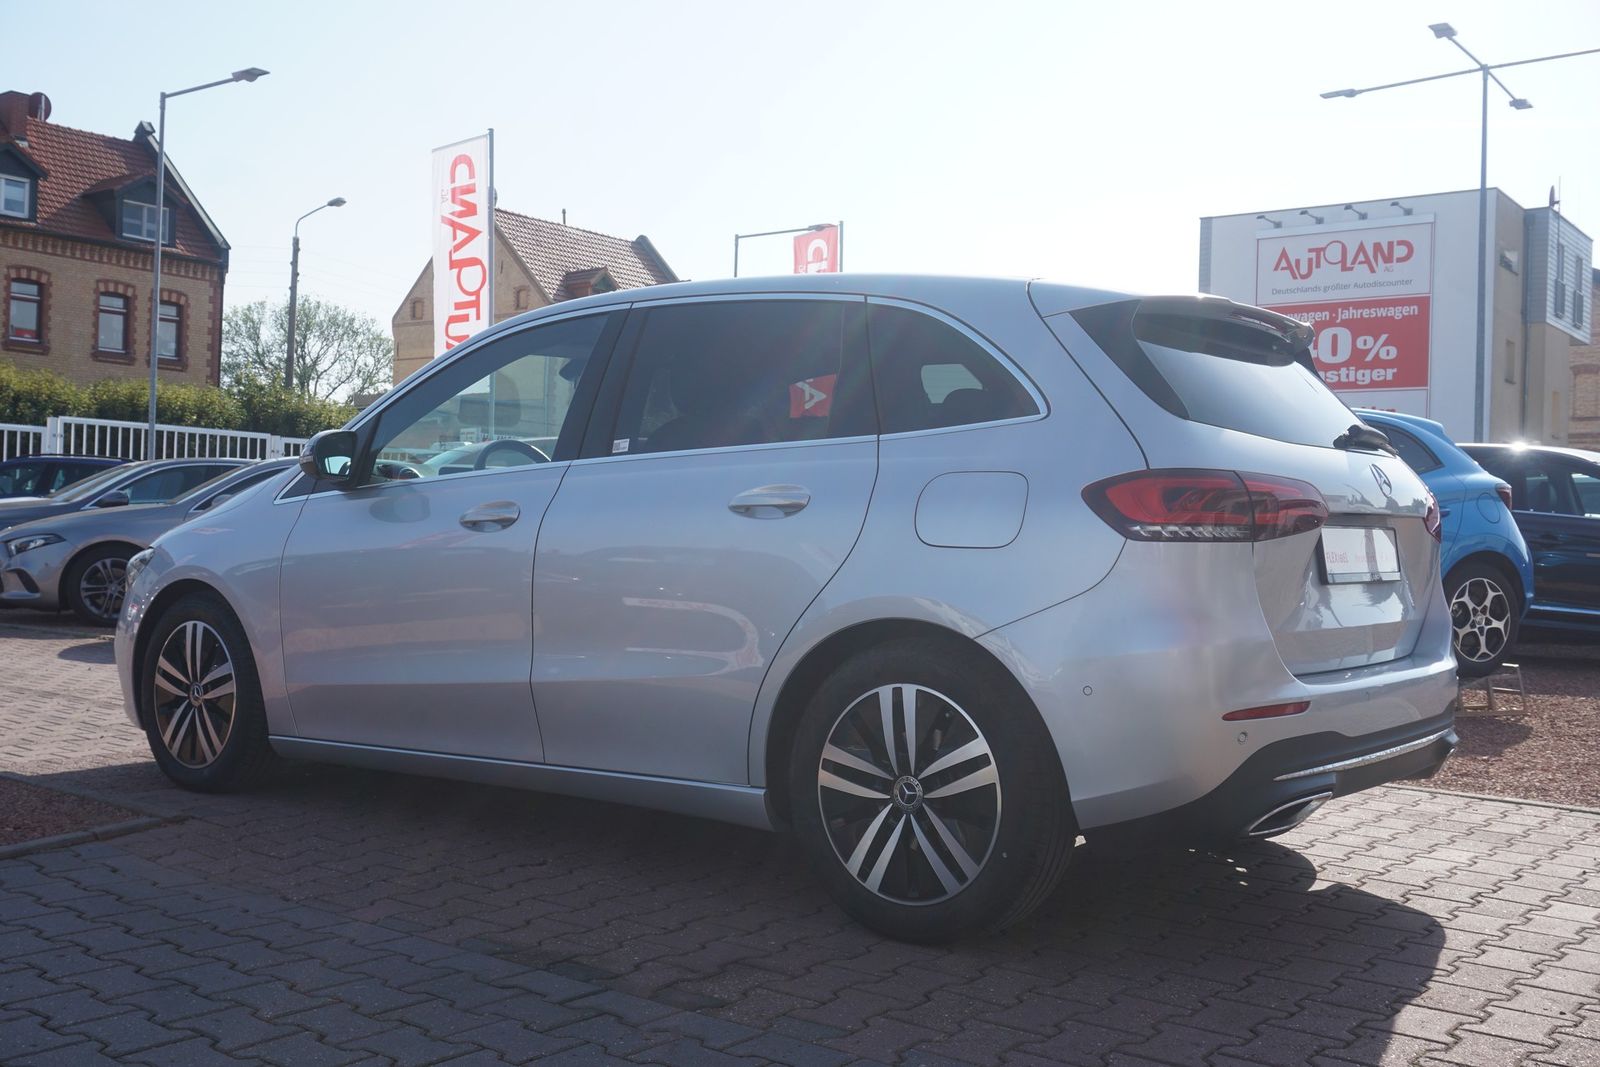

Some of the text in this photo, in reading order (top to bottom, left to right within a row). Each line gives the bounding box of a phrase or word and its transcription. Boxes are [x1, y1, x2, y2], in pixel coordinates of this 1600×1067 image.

[1273, 240, 1414, 280] AUTOLAND
[1271, 283, 1322, 295] Deutschlands
[1353, 279, 1413, 289] Autodiscounter
[1336, 305, 1418, 323] Jahreswagen
